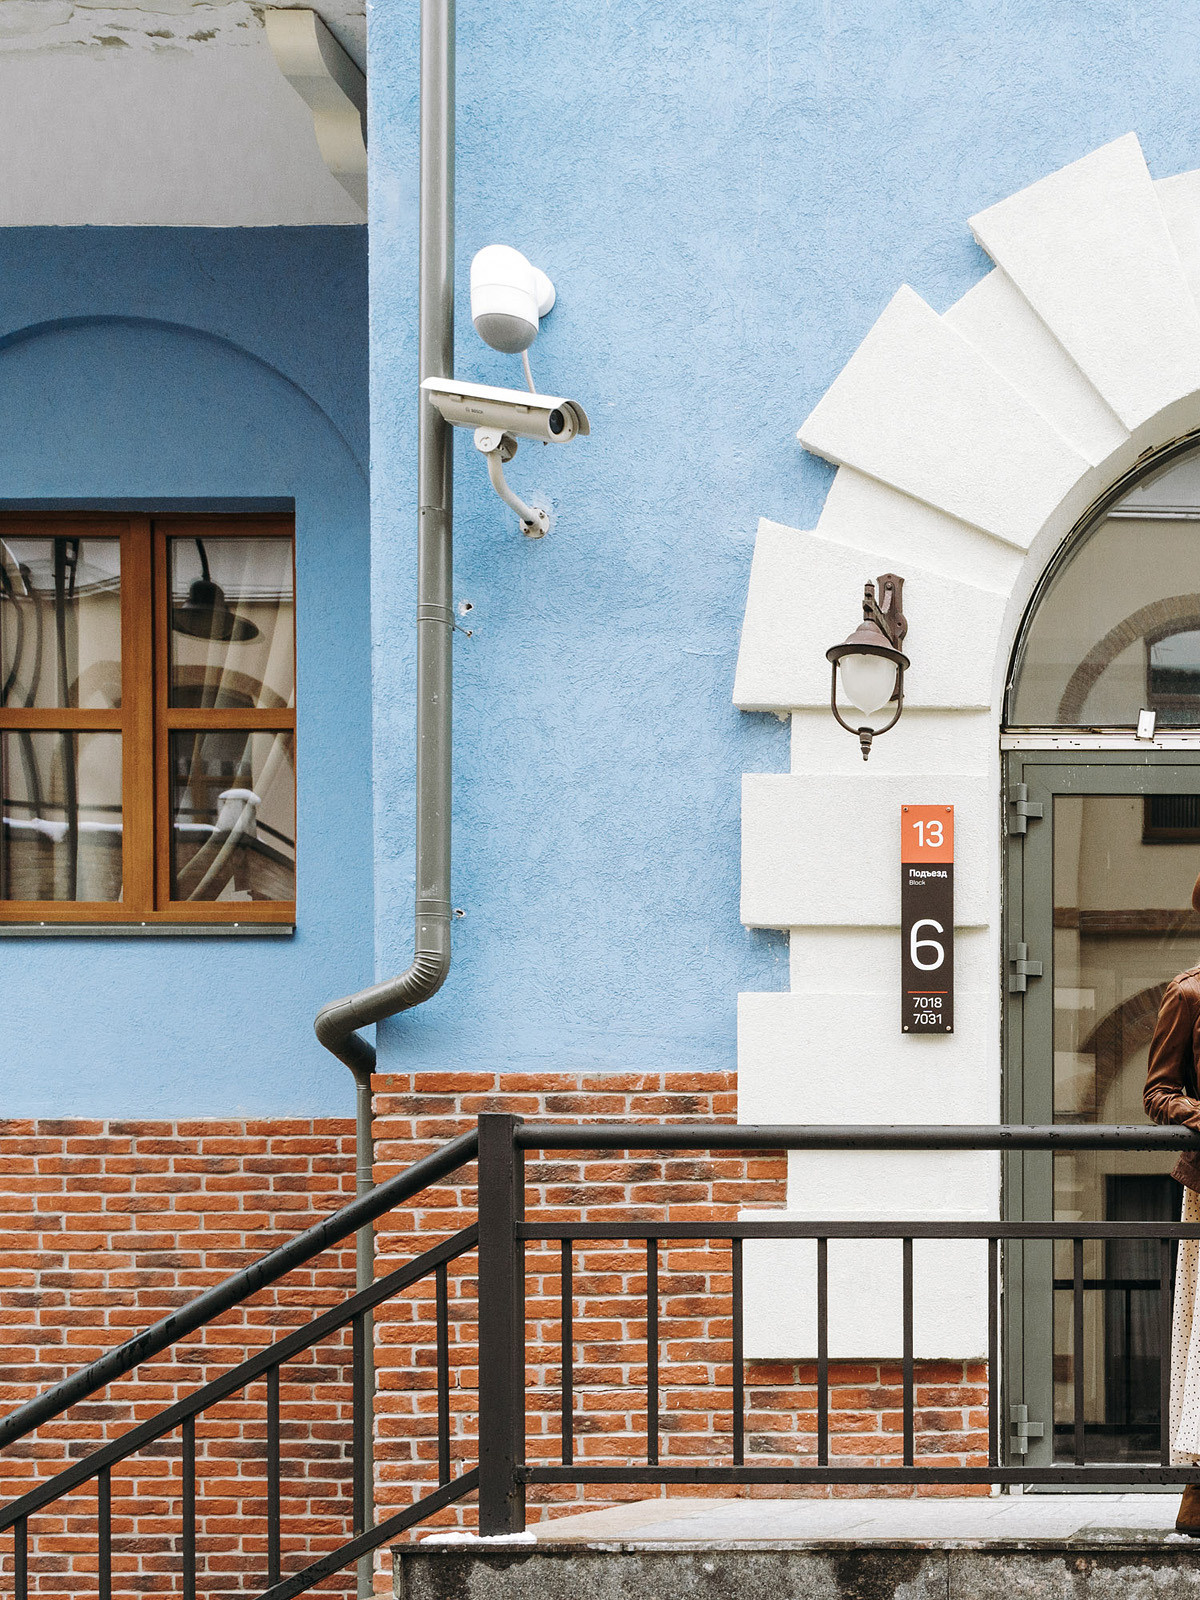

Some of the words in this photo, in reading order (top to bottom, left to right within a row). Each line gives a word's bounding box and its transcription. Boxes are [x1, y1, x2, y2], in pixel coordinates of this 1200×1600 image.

[912, 820, 944, 848] 13
[909, 869, 948, 879] Подъезд
[910, 918, 945, 971] 6
[912, 997, 943, 1008] 7018
[913, 1013, 942, 1025] 7031
